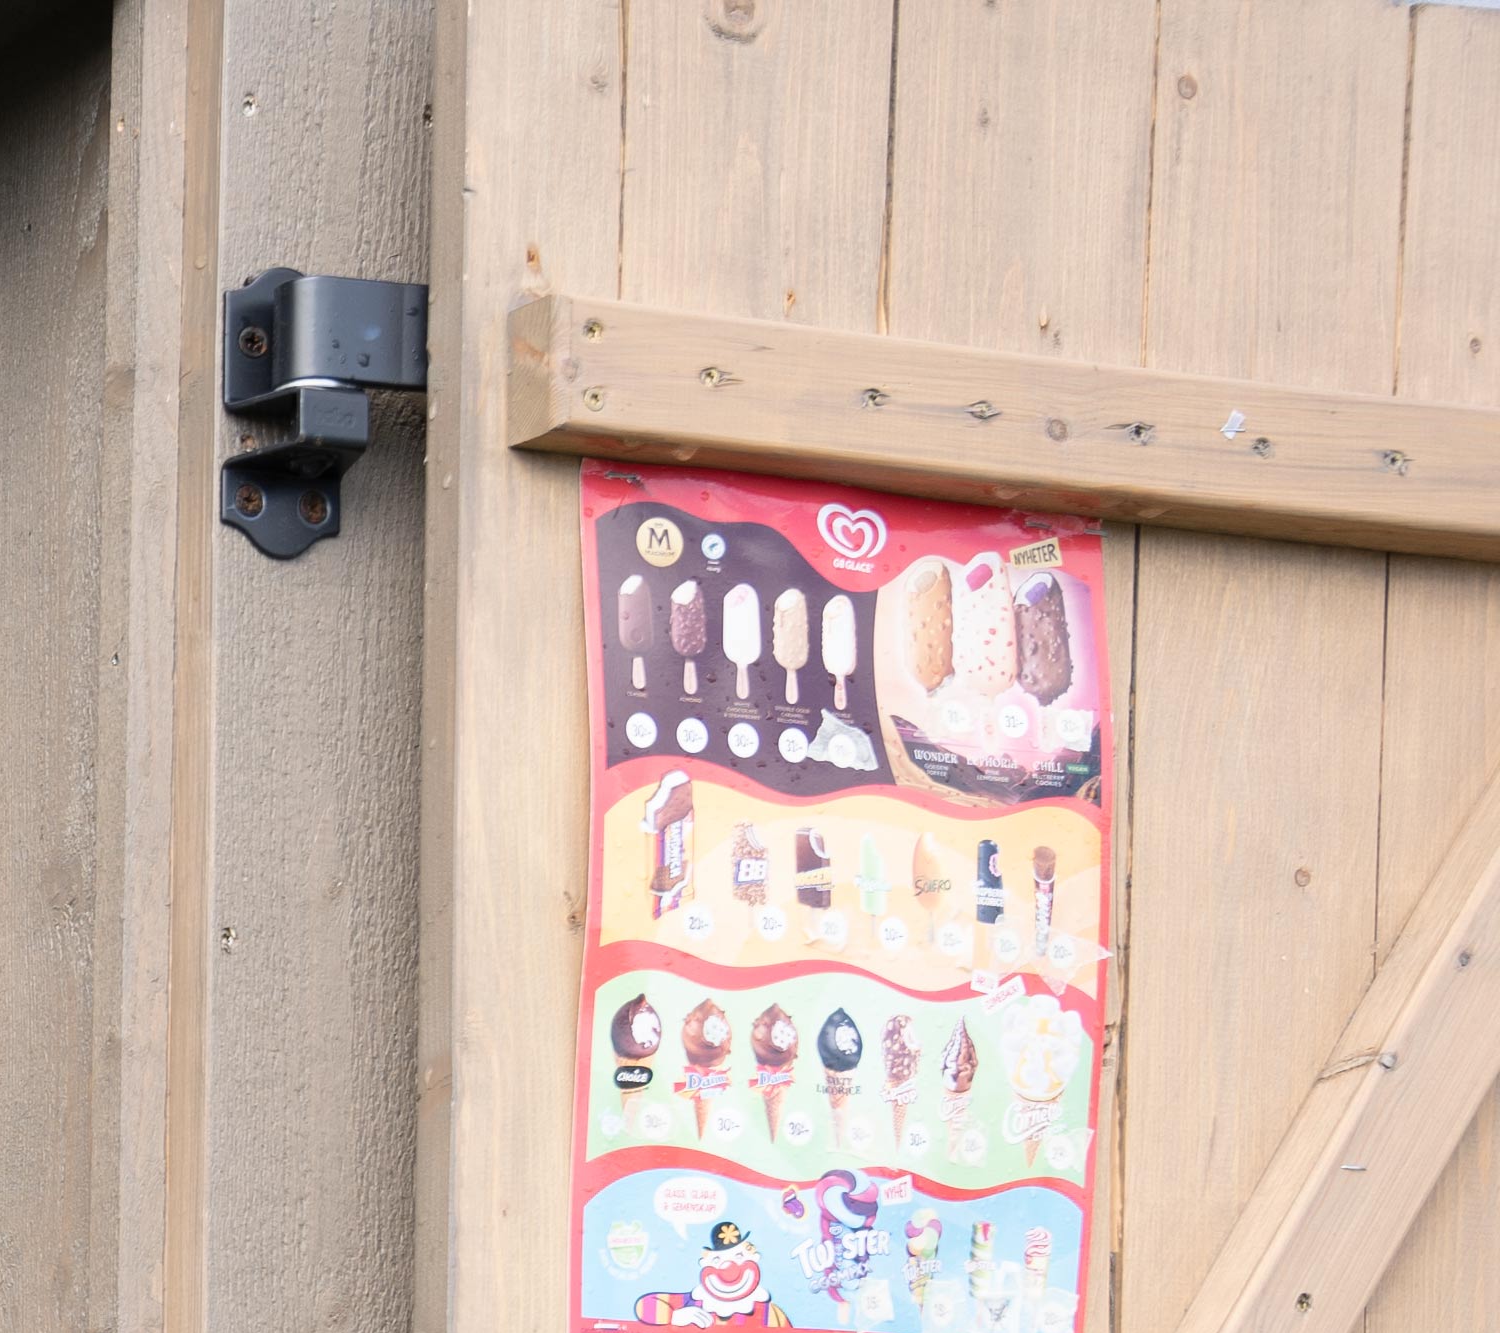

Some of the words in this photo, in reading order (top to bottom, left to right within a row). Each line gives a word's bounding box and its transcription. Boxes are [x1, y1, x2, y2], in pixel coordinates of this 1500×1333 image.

[647, 527, 672, 552] M
[1012, 543, 1059, 567] NYHETER
[734, 734, 756, 748] 30:-
[913, 749, 958, 764] WONDER
[1032, 760, 1064, 774] CHILL
[737, 859, 768, 883] 88
[685, 1072, 729, 1092] Daim
[757, 1070, 791, 1088] Daim
[815, 1084, 863, 1096] LICORICE
[716, 1116, 741, 1132] 30:-
[883, 1180, 911, 1202] NYHET
